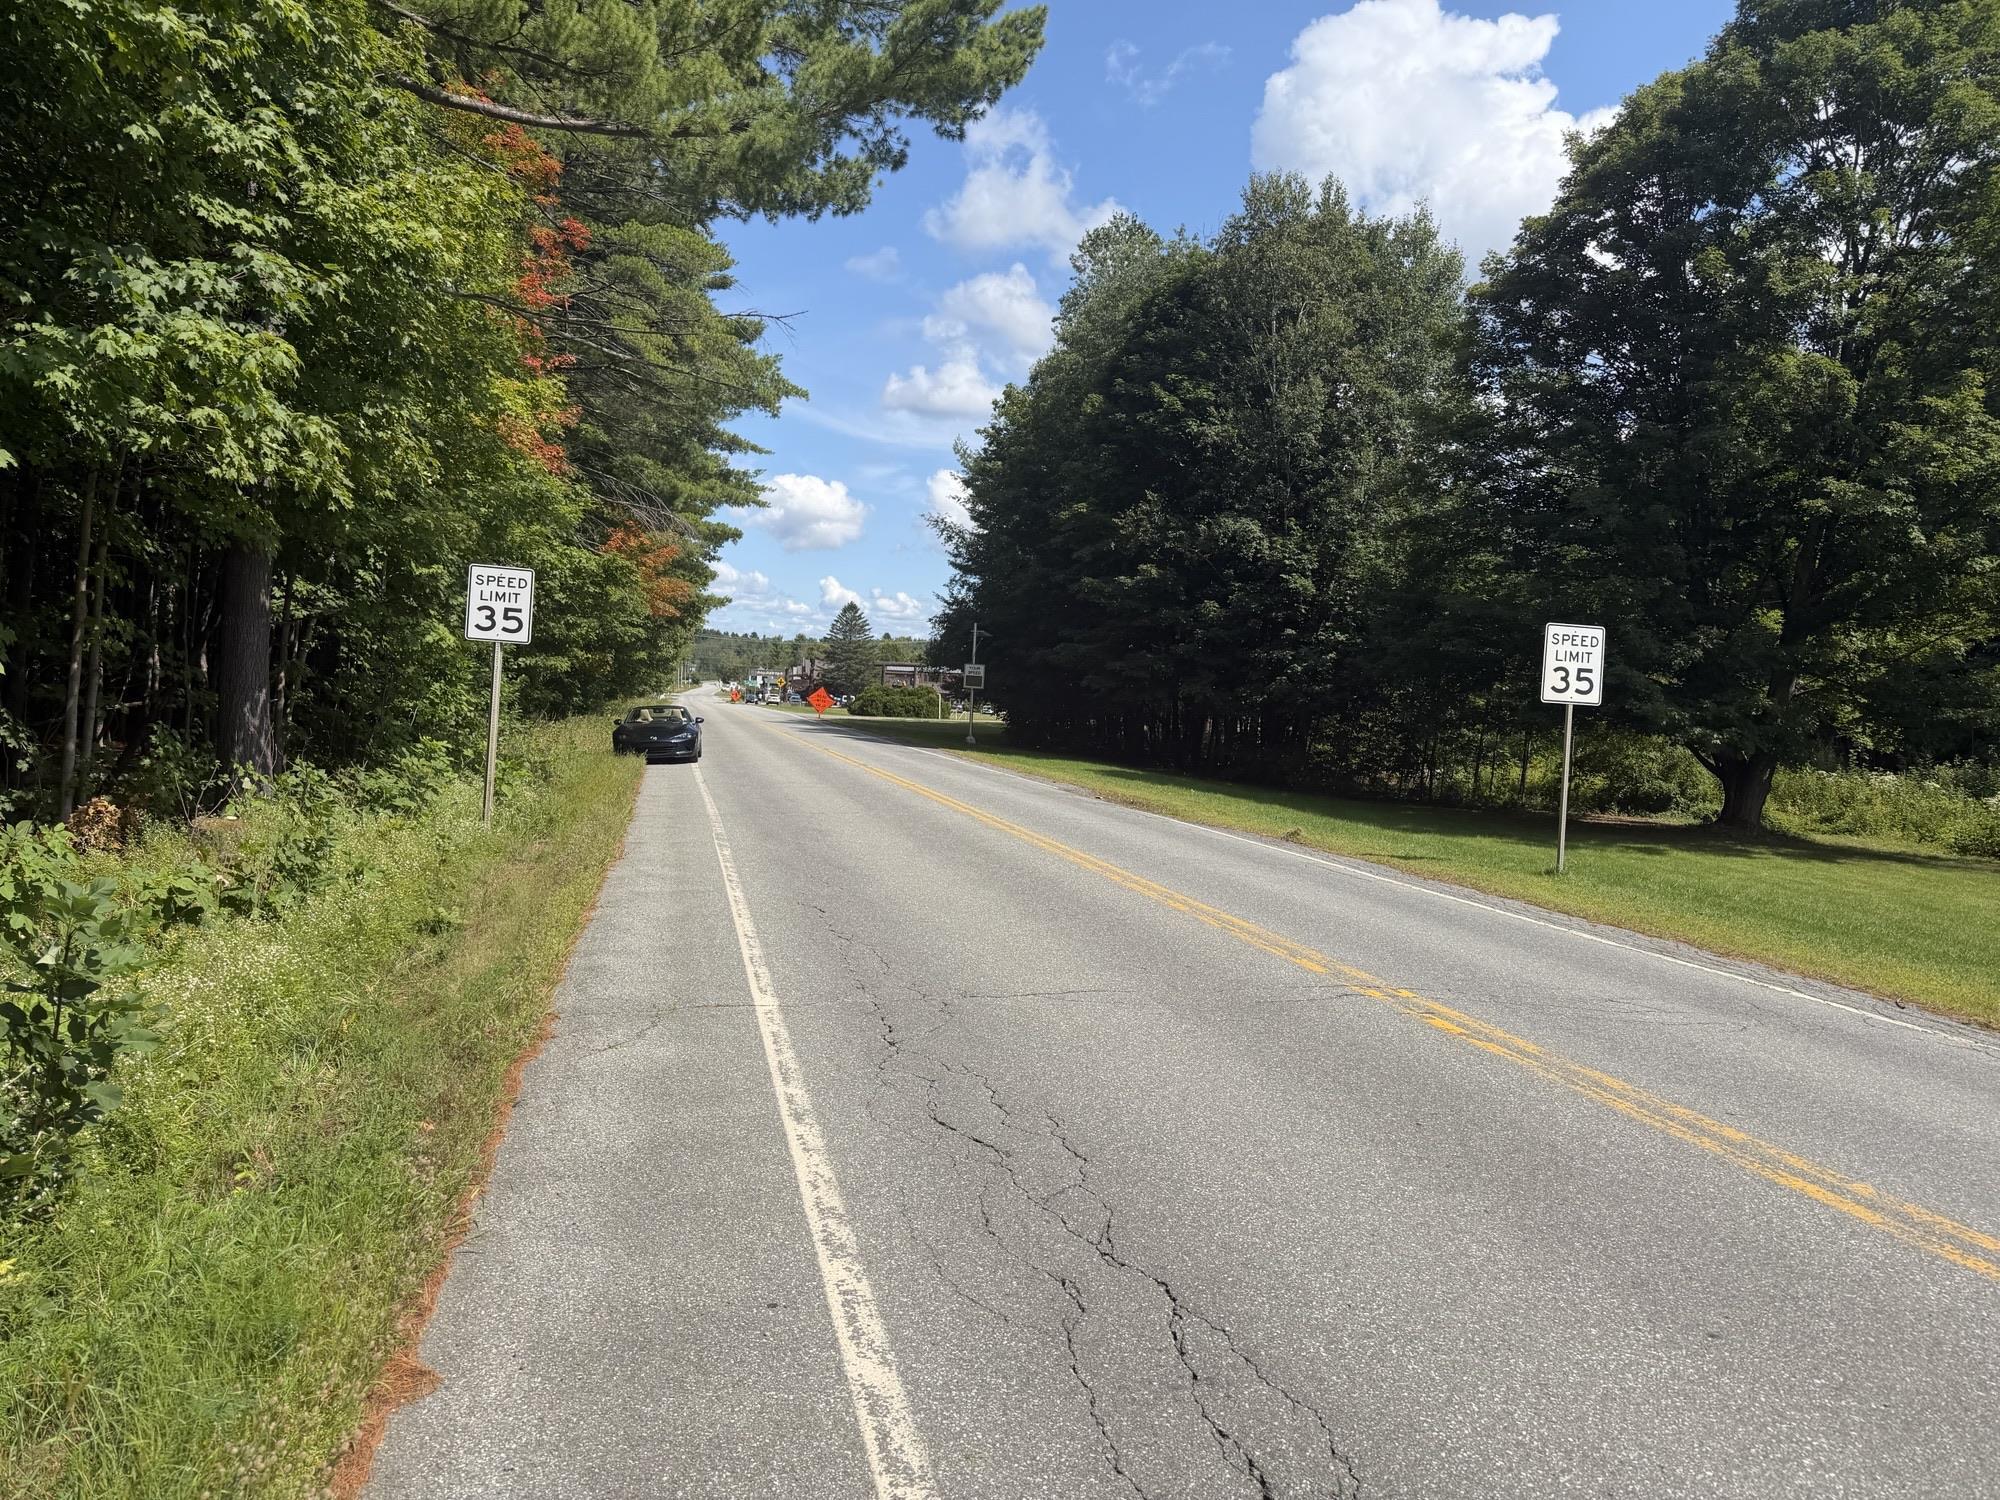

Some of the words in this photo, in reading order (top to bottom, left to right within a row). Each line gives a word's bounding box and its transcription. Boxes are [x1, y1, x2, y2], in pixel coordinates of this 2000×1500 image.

[475, 574, 528, 589] SPEED
[480, 590, 521, 604] LIMIT
[474, 605, 524, 634] 35
[1551, 633, 1599, 648] SPEED
[1555, 649, 1593, 664] LIMIT
[1550, 666, 1594, 696] 35
